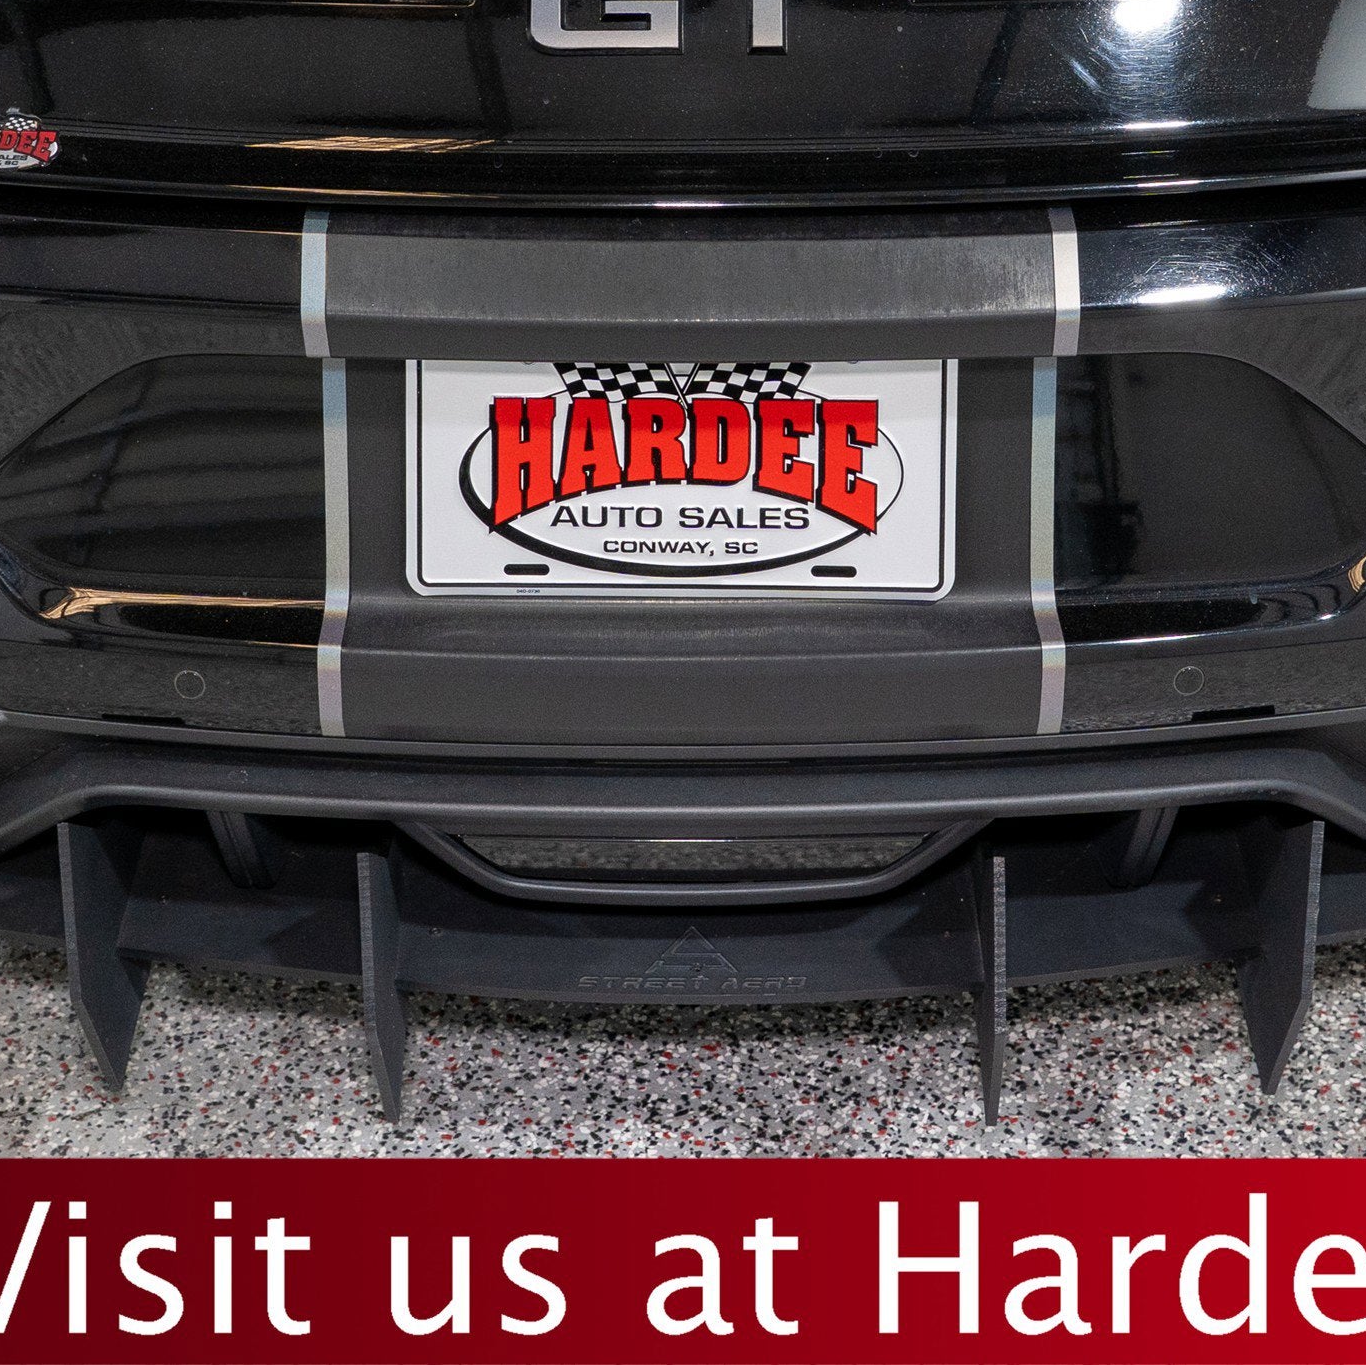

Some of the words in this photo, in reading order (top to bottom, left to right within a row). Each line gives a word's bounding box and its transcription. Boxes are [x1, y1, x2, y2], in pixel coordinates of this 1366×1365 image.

[489, 396, 879, 534] HARDEE
[550, 506, 663, 528] AUTO
[679, 506, 810, 529] SALES
[603, 540, 714, 556] CONWAY,
[724, 541, 758, 555] SC
[578, 974, 710, 990] STREET
